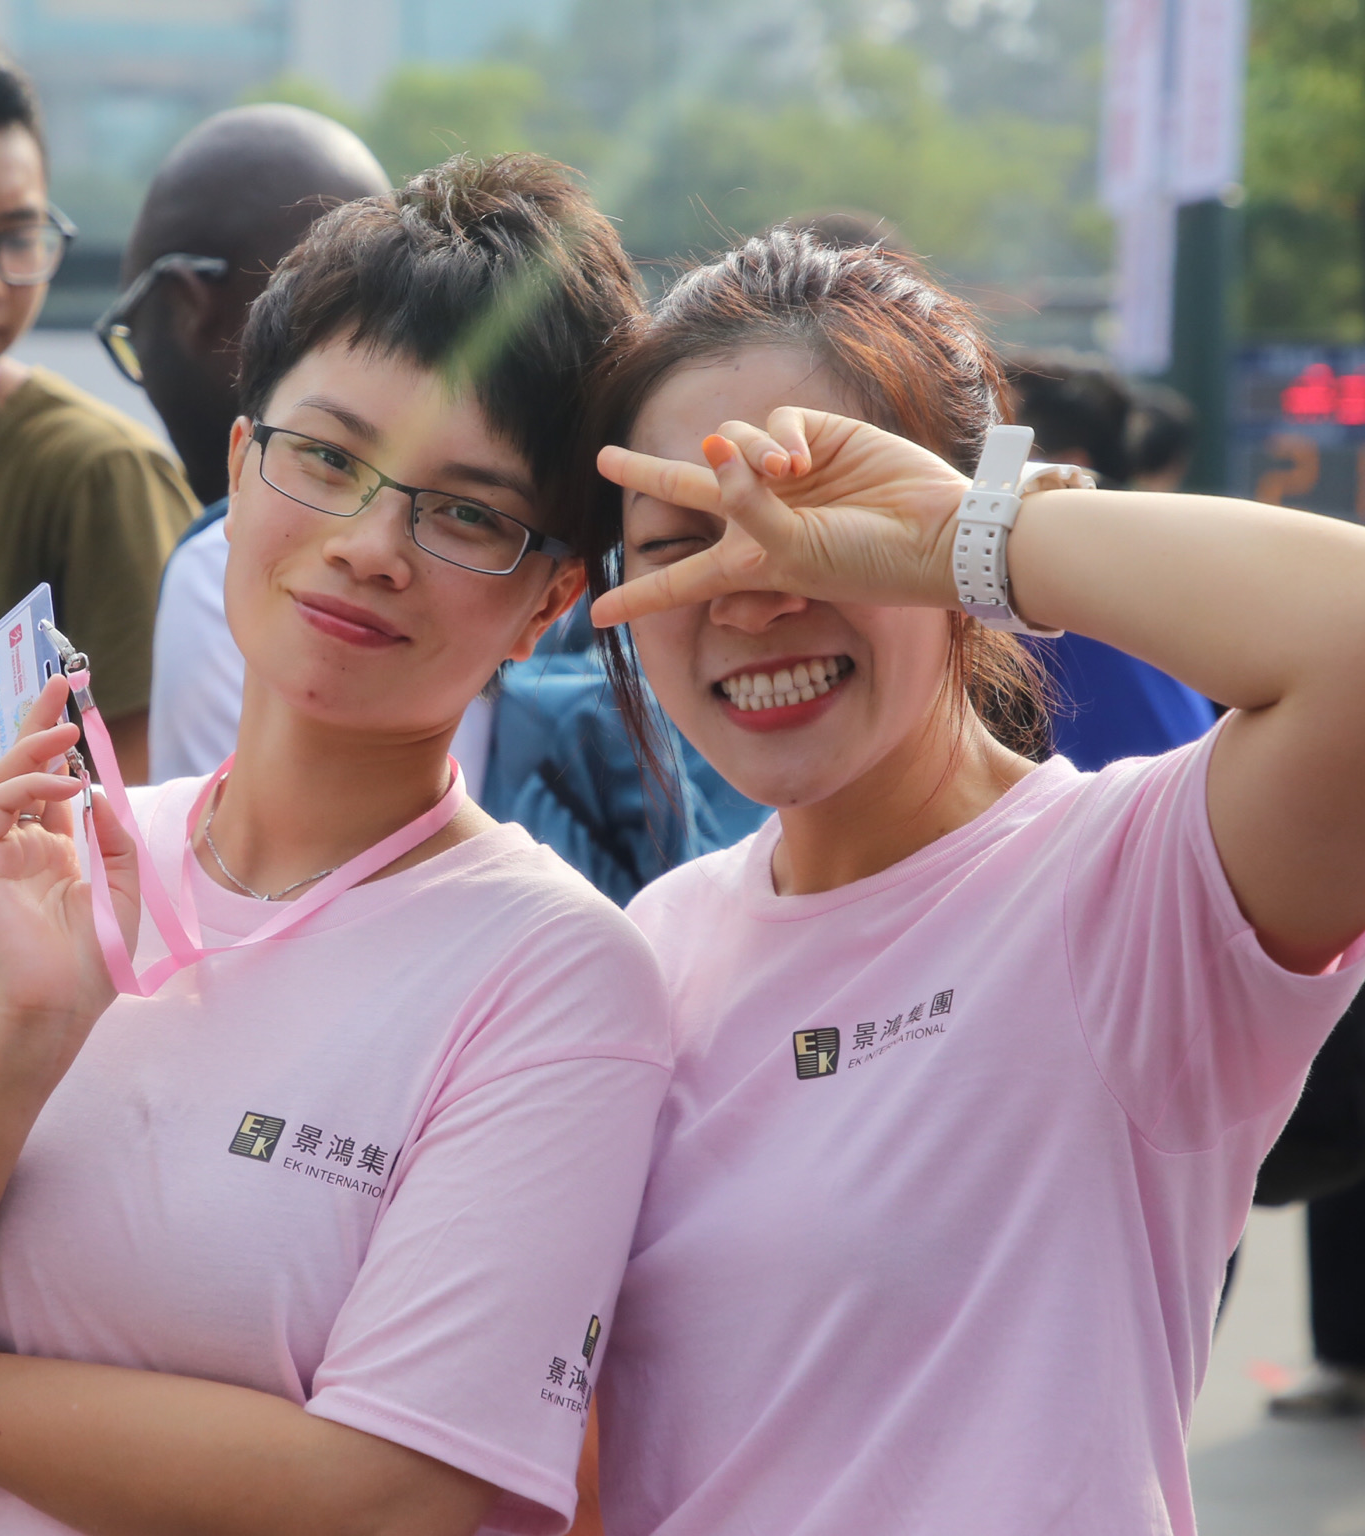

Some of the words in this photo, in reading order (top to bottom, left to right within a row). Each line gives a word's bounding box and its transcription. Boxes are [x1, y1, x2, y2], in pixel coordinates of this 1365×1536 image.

[852, 989, 954, 1050] 景鴻集團
[283, 1157, 302, 1172] EK
[291, 1124, 395, 1179] 景鴻集
